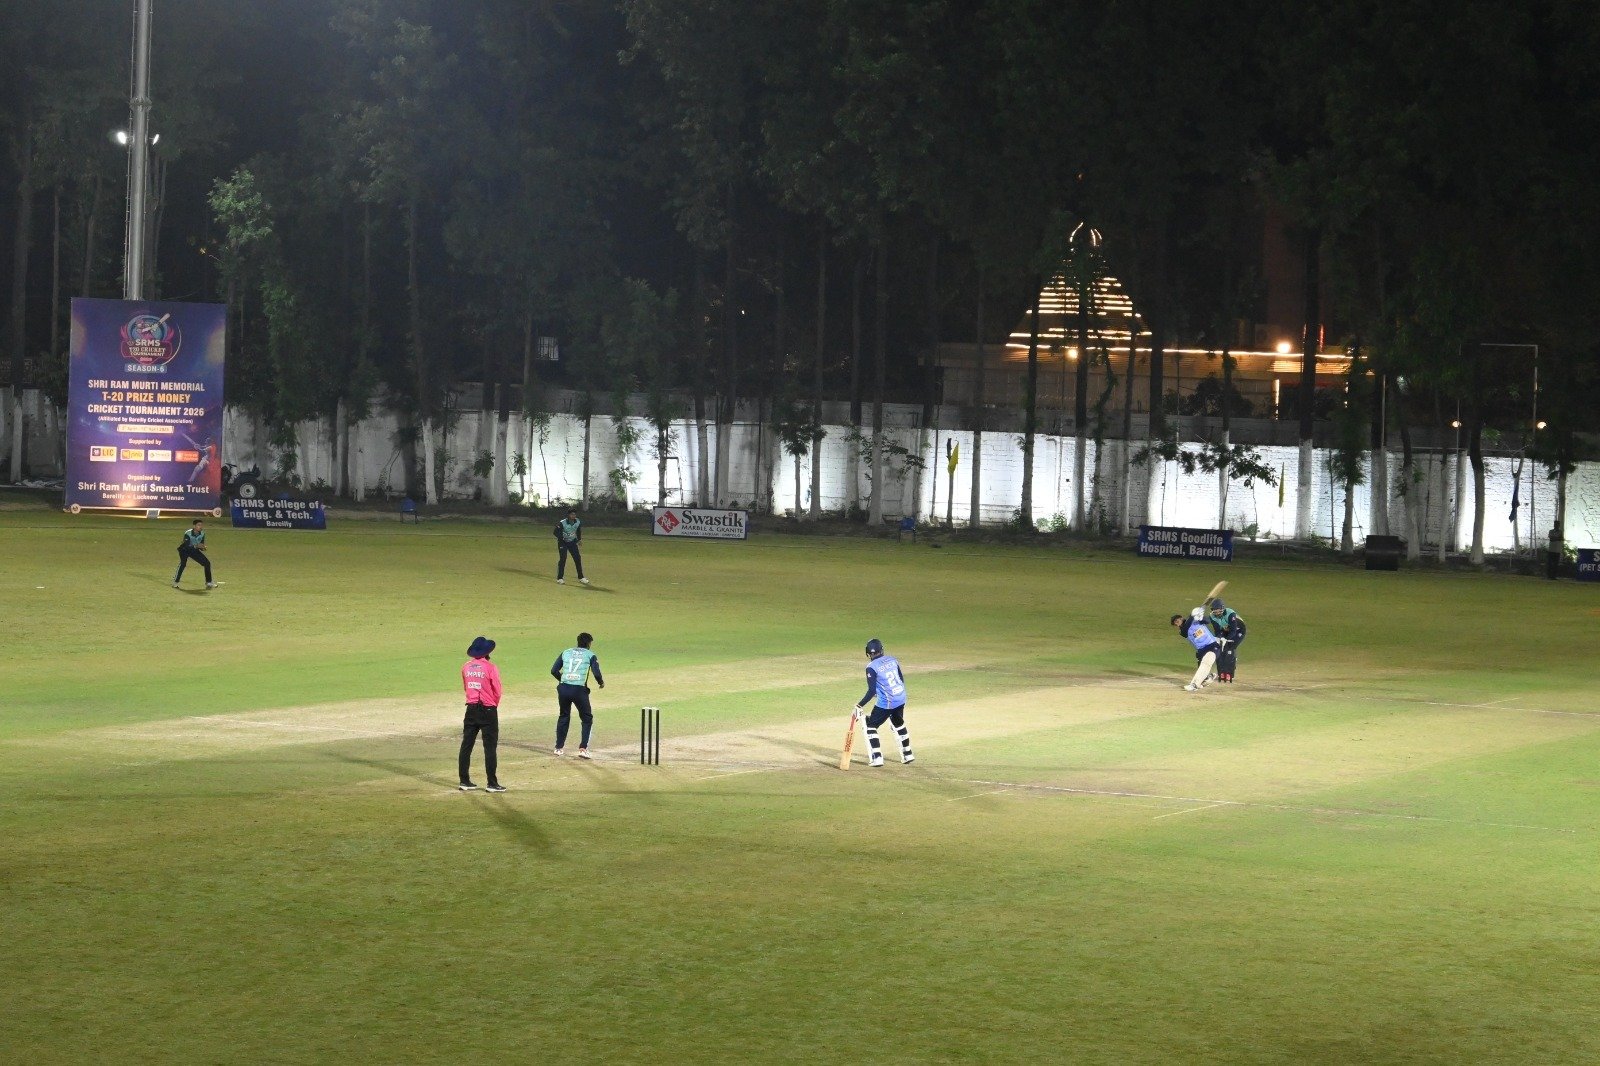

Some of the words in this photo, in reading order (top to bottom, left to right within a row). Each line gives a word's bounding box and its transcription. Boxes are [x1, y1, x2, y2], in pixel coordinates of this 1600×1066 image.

[88, 380, 107, 388] SHRI
[111, 380, 129, 389] RAM
[132, 381, 158, 390] MURTI
[161, 382, 205, 392] MEMORIAL
[102, 392, 123, 401] T-20
[127, 392, 154, 402] PRIZE
[157, 393, 190, 403] MONEY
[88, 404, 123, 414] CRICKET
[125, 405, 181, 416] TOURNAMENT
[183, 408, 204, 416] 2026
[102, 448, 113, 457] LIC
[78, 482, 96, 490] Shri
[99, 483, 119, 491] Ram
[122, 483, 147, 492] Murti
[150, 483, 184, 493] Smarak
[187, 484, 209, 494] Trust
[234, 499, 264, 508] SRMS
[268, 499, 306, 510] College
[309, 500, 319, 509] of
[243, 510, 272, 519] Engg.
[275, 510, 283, 518] &
[286, 510, 313, 519] Tech.
[682, 510, 743, 527] Swastik
[1148, 530, 1177, 542] SRMS
[1180, 532, 1223, 544] Goodlife
[1140, 542, 1186, 556] Hospital,
[1189, 545, 1228, 559] Bareilly
[569, 659, 582, 672] 17
